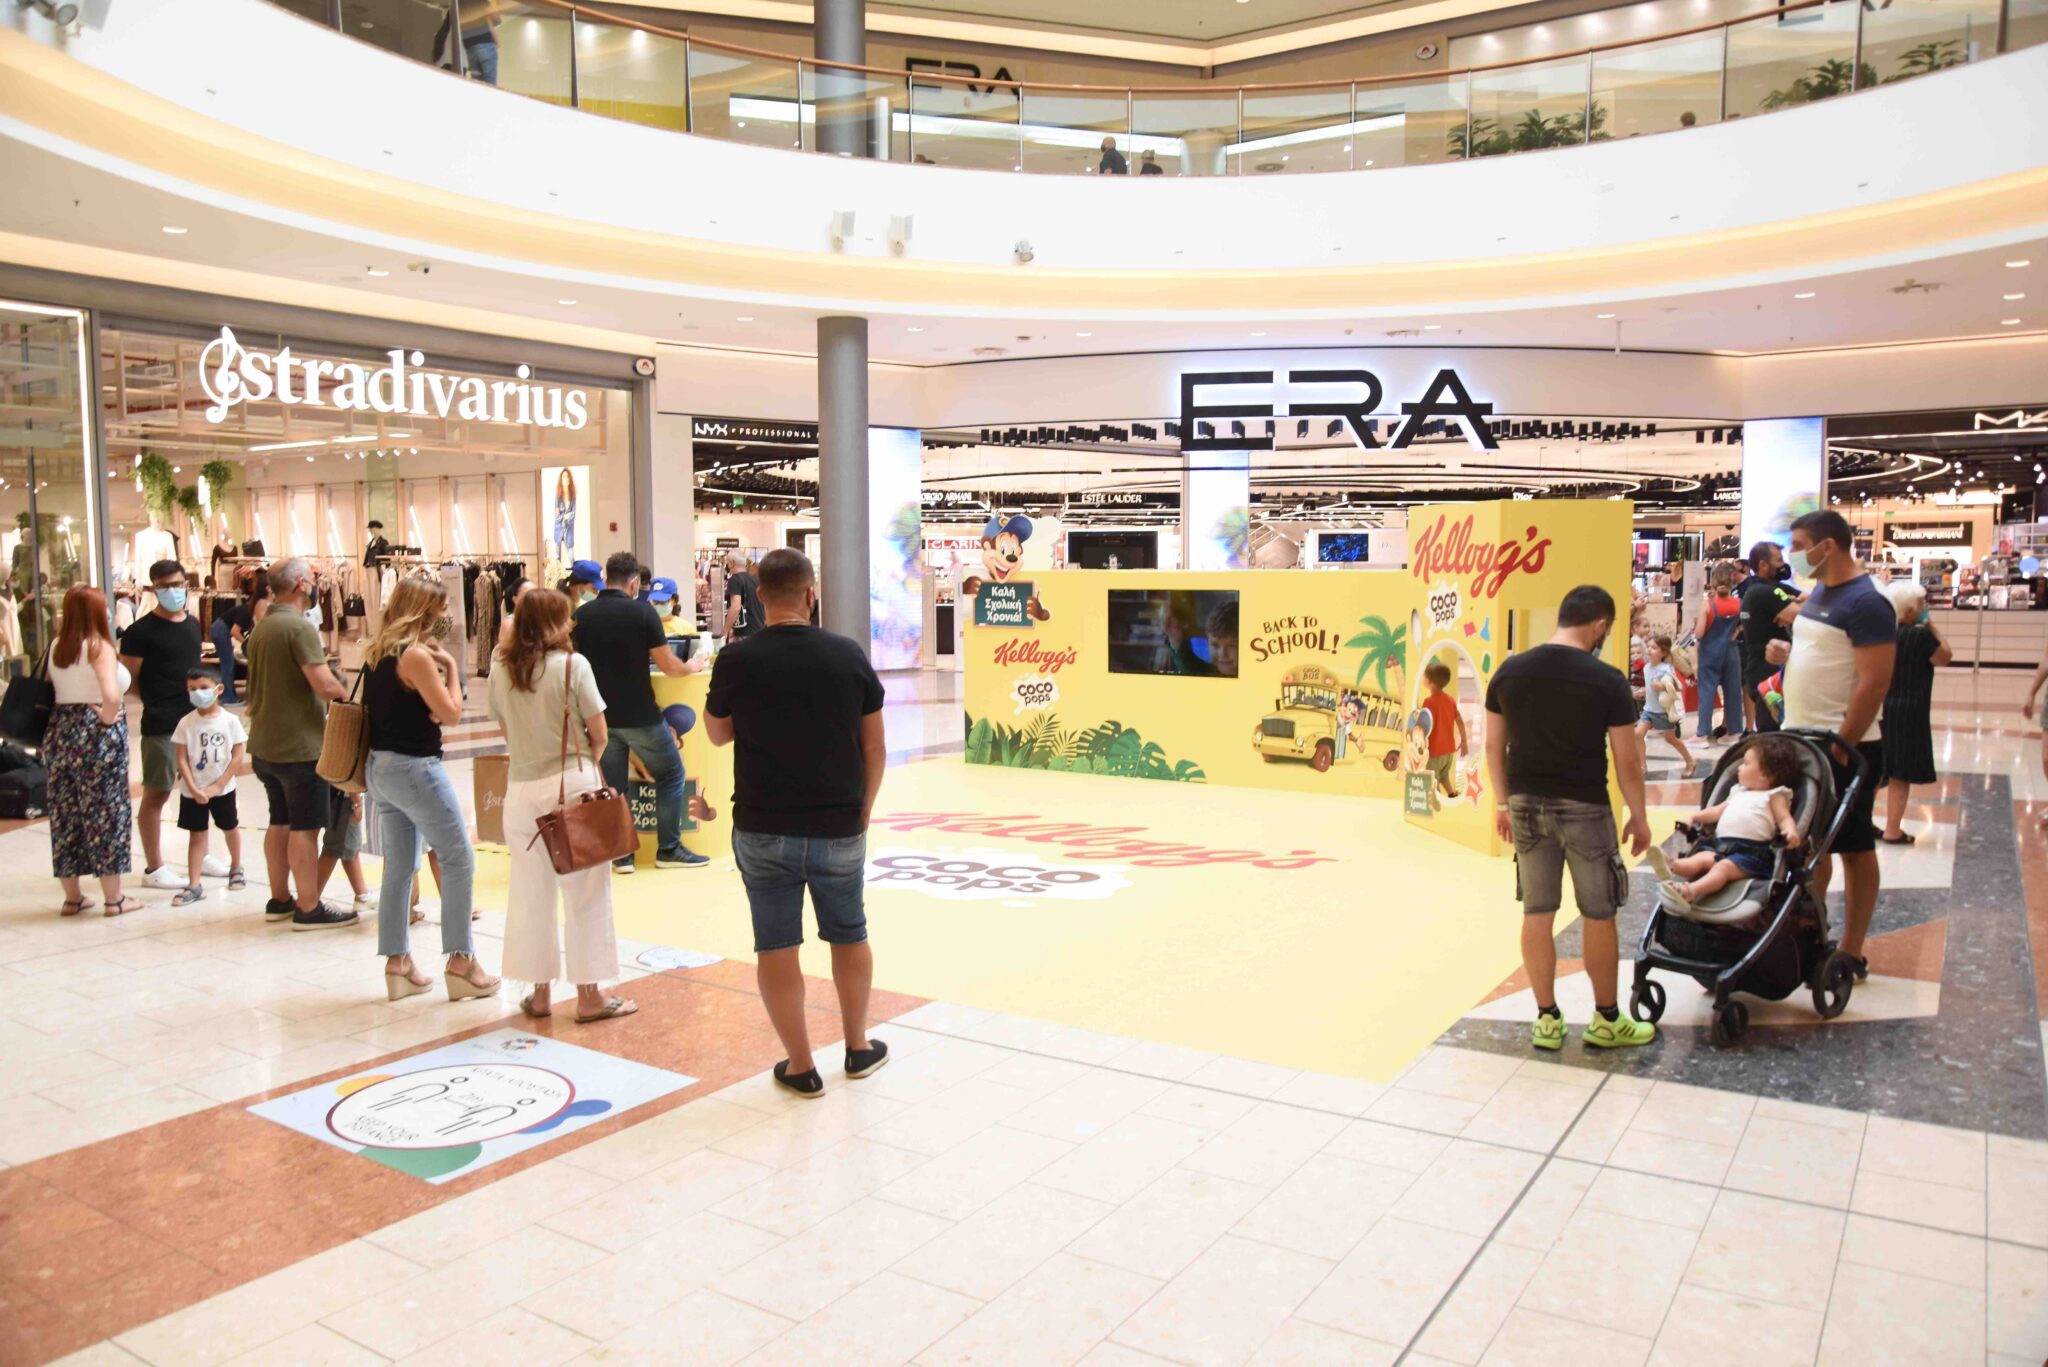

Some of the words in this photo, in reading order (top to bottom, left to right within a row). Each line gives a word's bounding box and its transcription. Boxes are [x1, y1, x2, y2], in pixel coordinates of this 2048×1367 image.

[1181, 369, 1500, 450] ERA
[694, 422, 728, 436] NYX
[739, 427, 812, 438] PROFESSIONAL
[1107, 494, 1142, 503] LAUDER
[931, 539, 982, 549] CLARIN
[1413, 514, 1552, 599] Kellogg's
[991, 585, 1016, 599] Καλή
[984, 598, 1022, 612] Σχολική
[986, 610, 1023, 624] Χρονιά!
[1263, 615, 1297, 634] BACK
[1301, 615, 1318, 629] TO
[1250, 629, 1340, 662] SCHOOL!
[993, 637, 1078, 674] Kellogg's
[1024, 692, 1051, 707] pops
[639, 786, 656, 798] Κα
[869, 812, 1339, 869] Kellogg's
